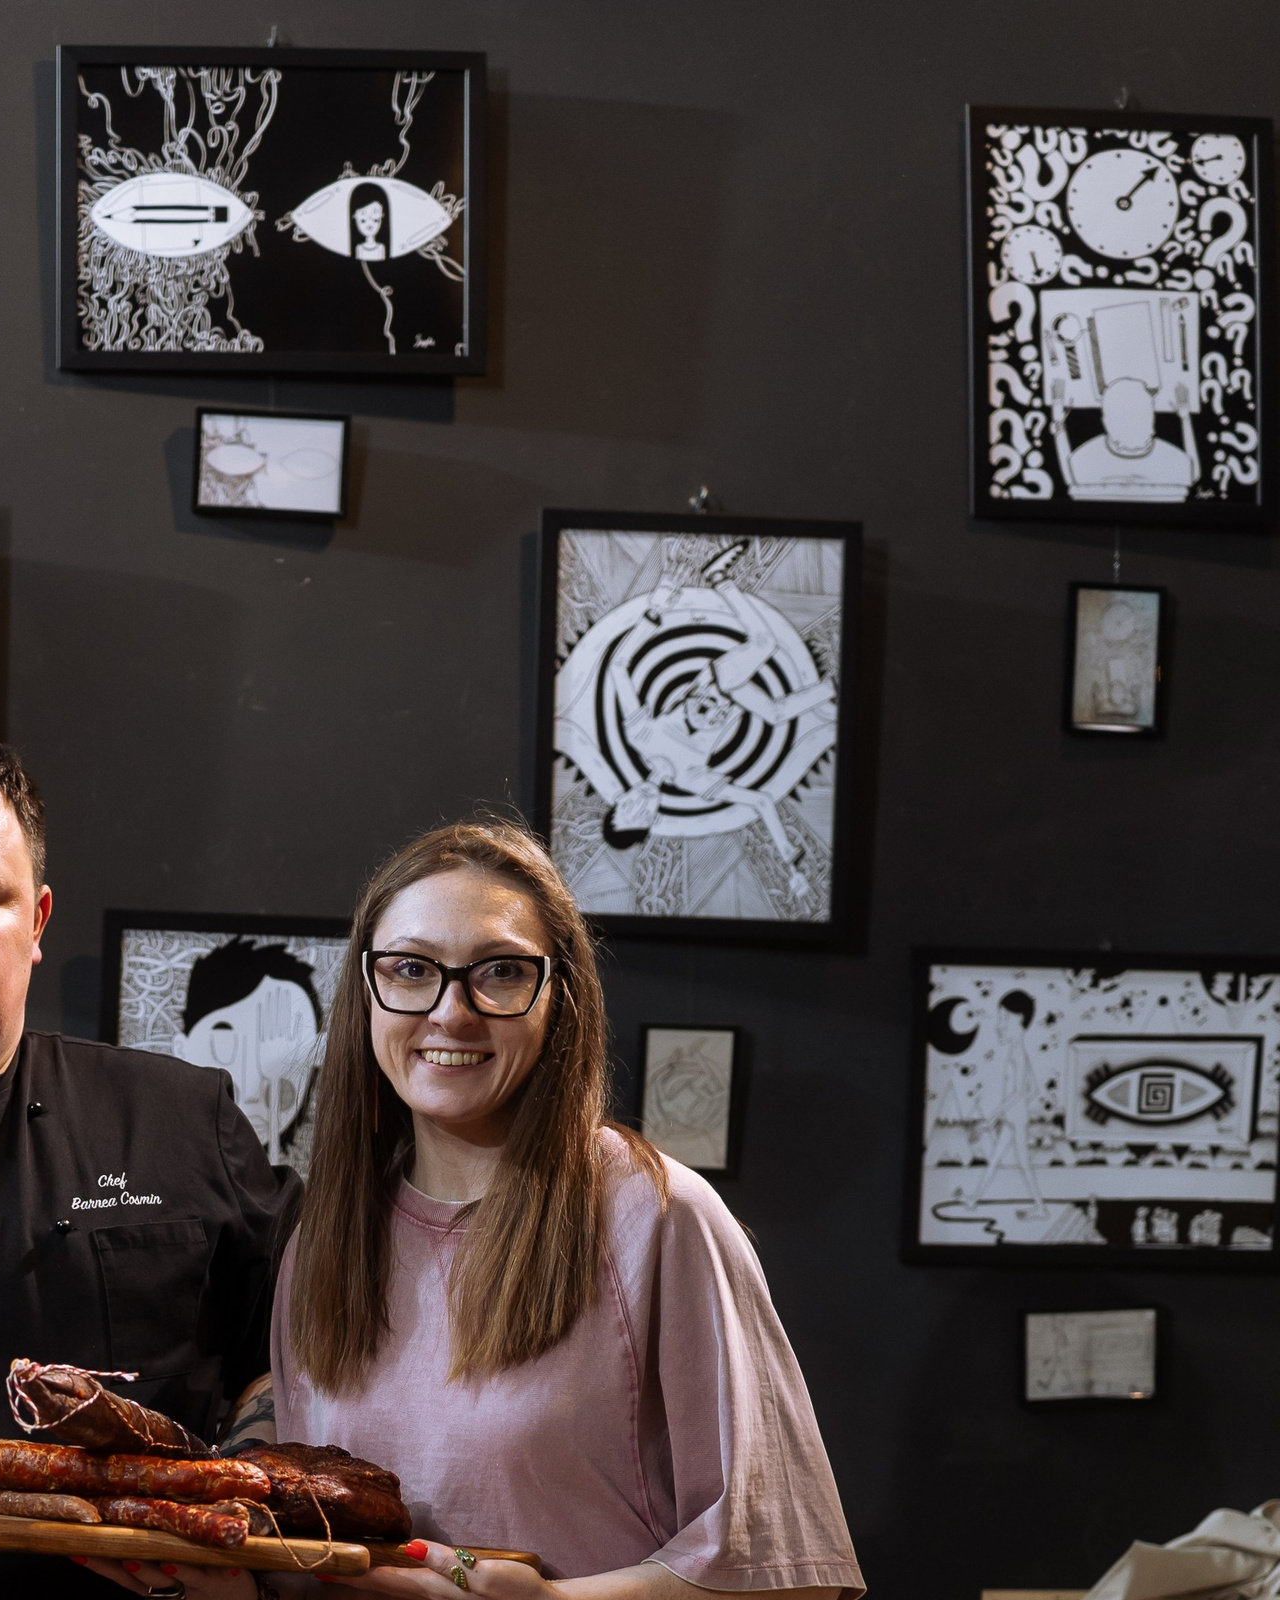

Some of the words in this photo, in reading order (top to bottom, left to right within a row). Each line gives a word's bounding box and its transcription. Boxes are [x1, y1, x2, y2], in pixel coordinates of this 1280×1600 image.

[97, 1172, 128, 1190] Chef
[71, 1197, 118, 1210] Barnea
[120, 1191, 163, 1206] Cosmin
